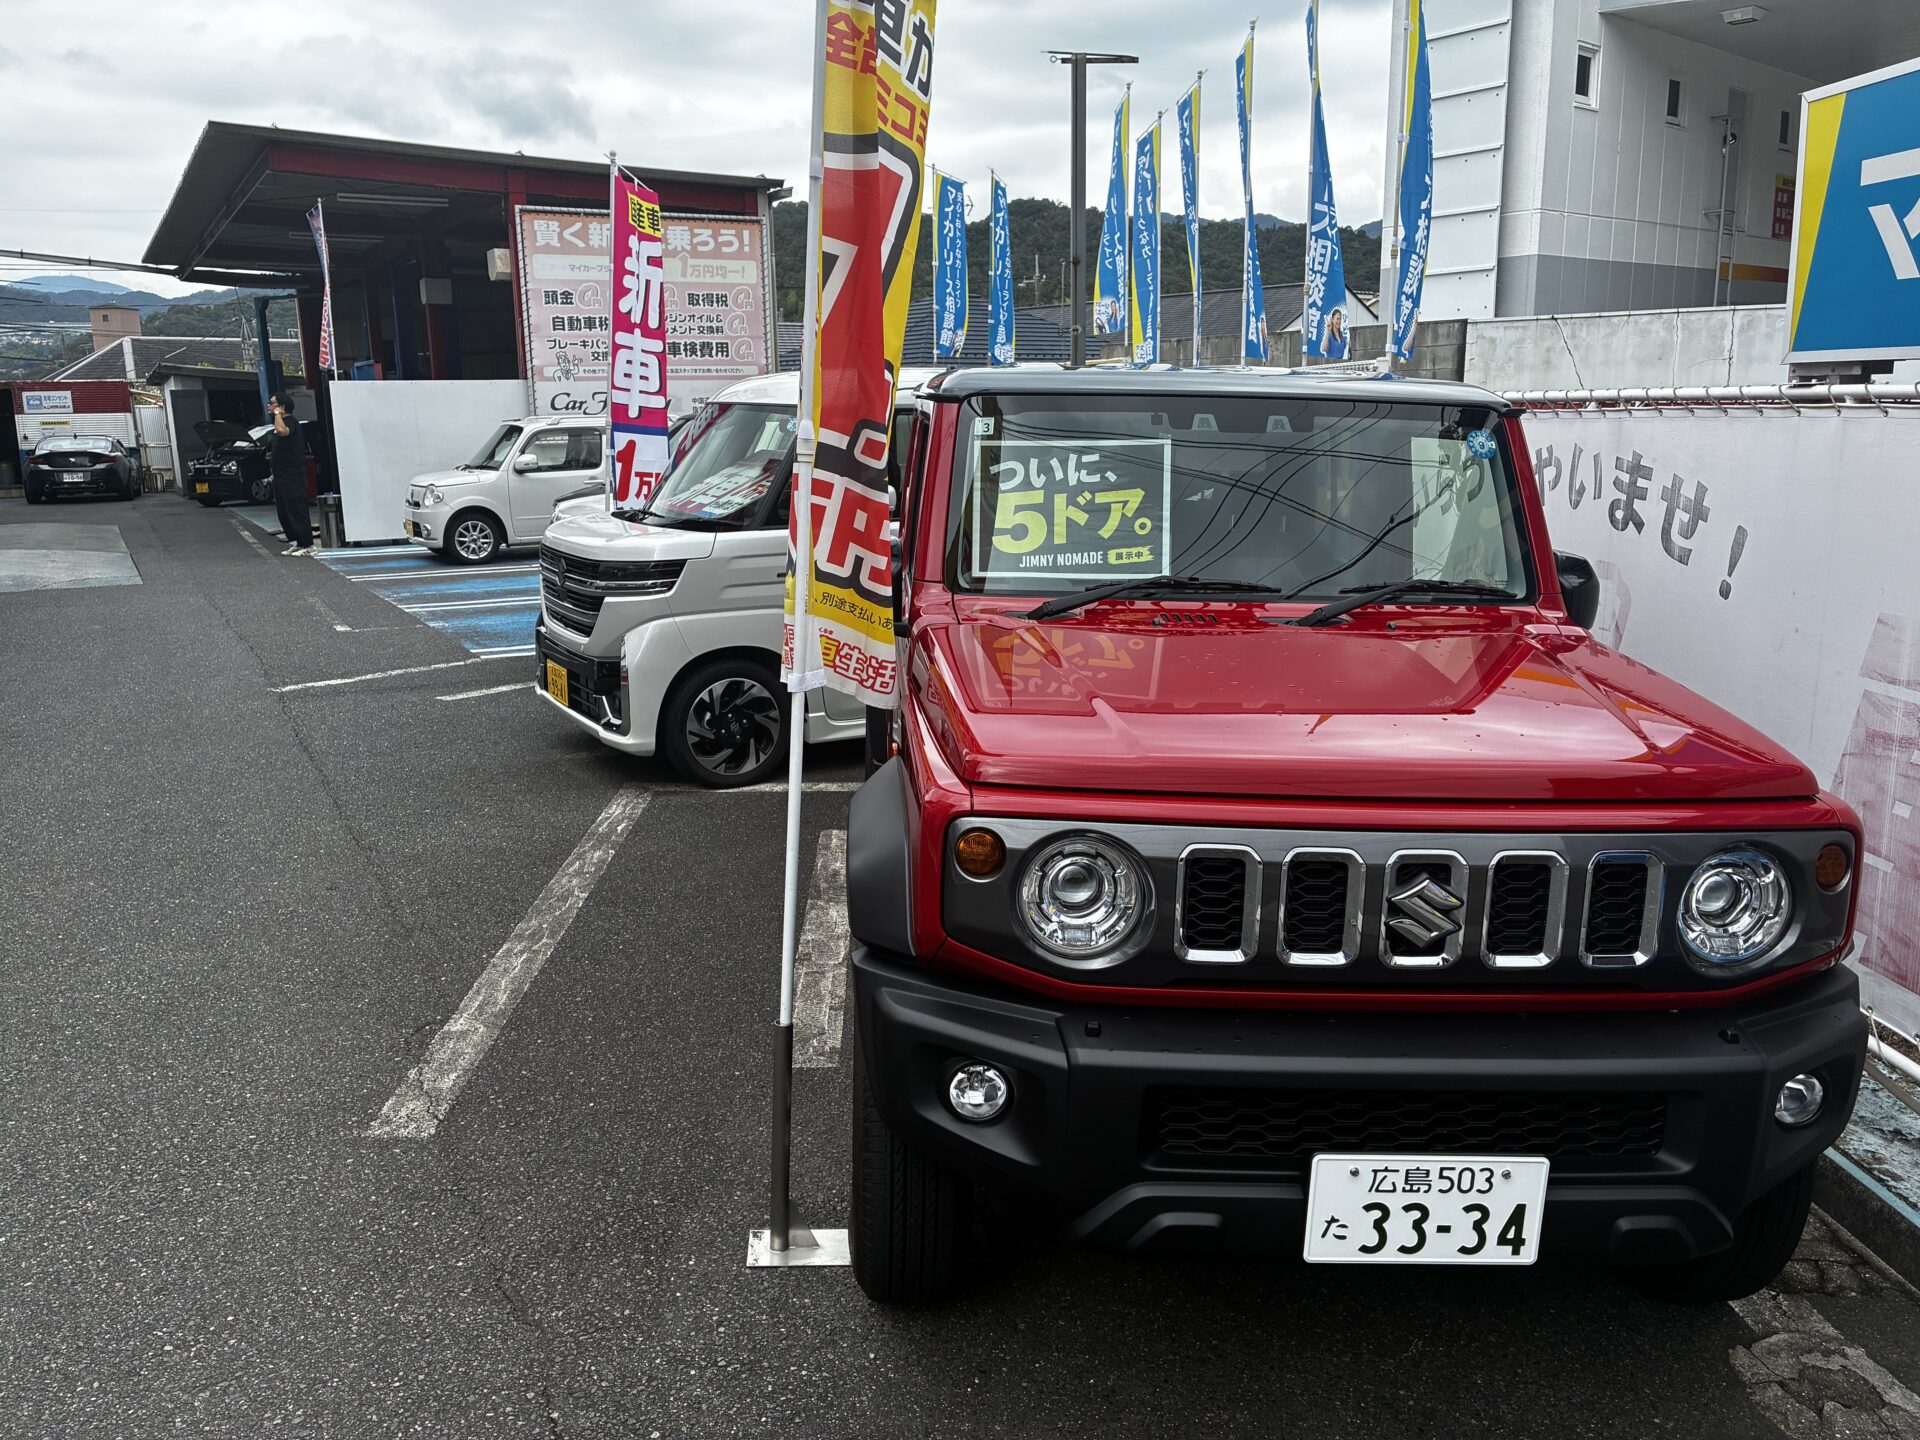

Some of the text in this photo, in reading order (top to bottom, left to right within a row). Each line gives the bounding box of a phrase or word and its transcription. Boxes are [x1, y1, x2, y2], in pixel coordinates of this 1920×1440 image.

[543, 290, 575, 305] 頭金
[687, 292, 729, 307] 取得税
[667, 341, 730, 358] 車検費用
[550, 392, 587, 411] Car
[991, 487, 1152, 554] 5ドア。
[1019, 551, 1104, 568] JIMNY NOMADE
[1321, 1201, 1527, 1256] た 33-34
